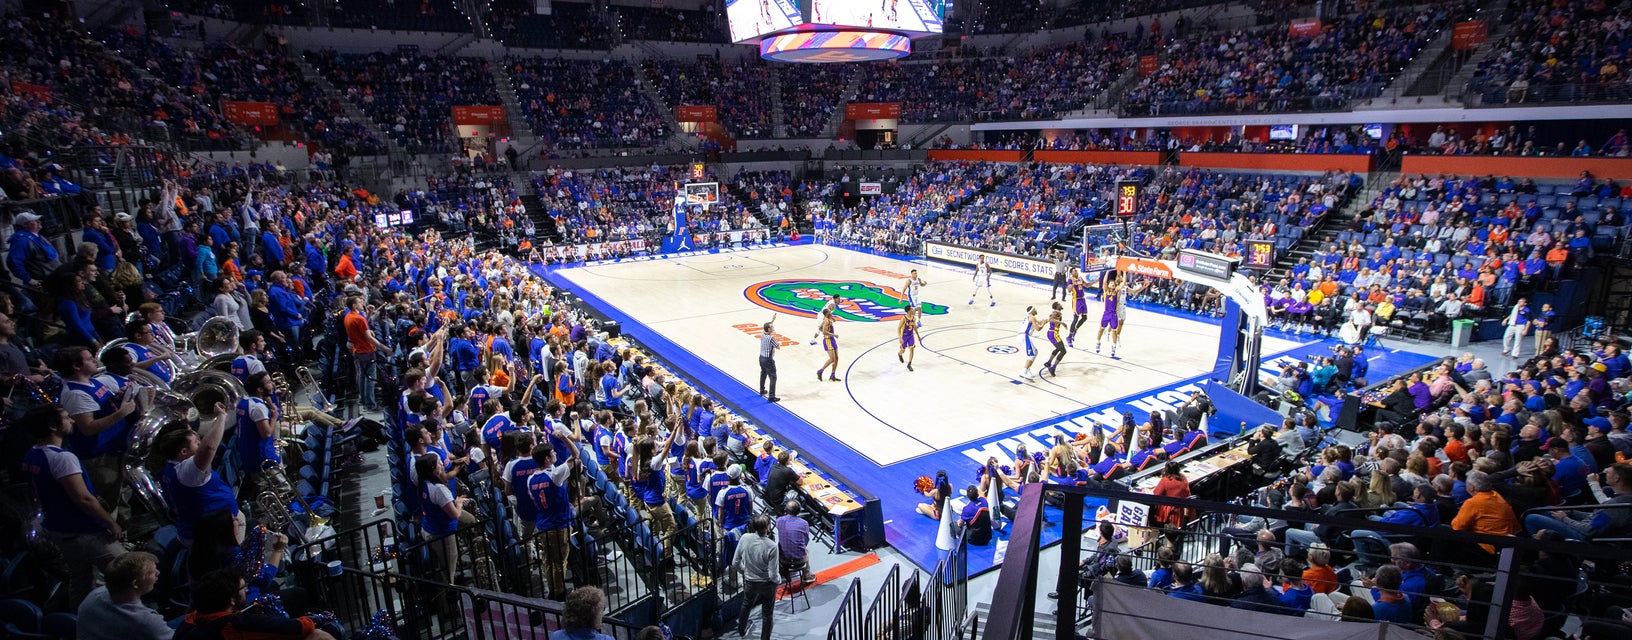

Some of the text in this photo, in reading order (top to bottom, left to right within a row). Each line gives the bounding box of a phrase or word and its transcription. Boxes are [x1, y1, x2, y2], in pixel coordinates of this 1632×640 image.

[1120, 197, 1133, 213] 30
[1253, 243, 1270, 254] 7:53
[1253, 253, 1266, 265] 30
